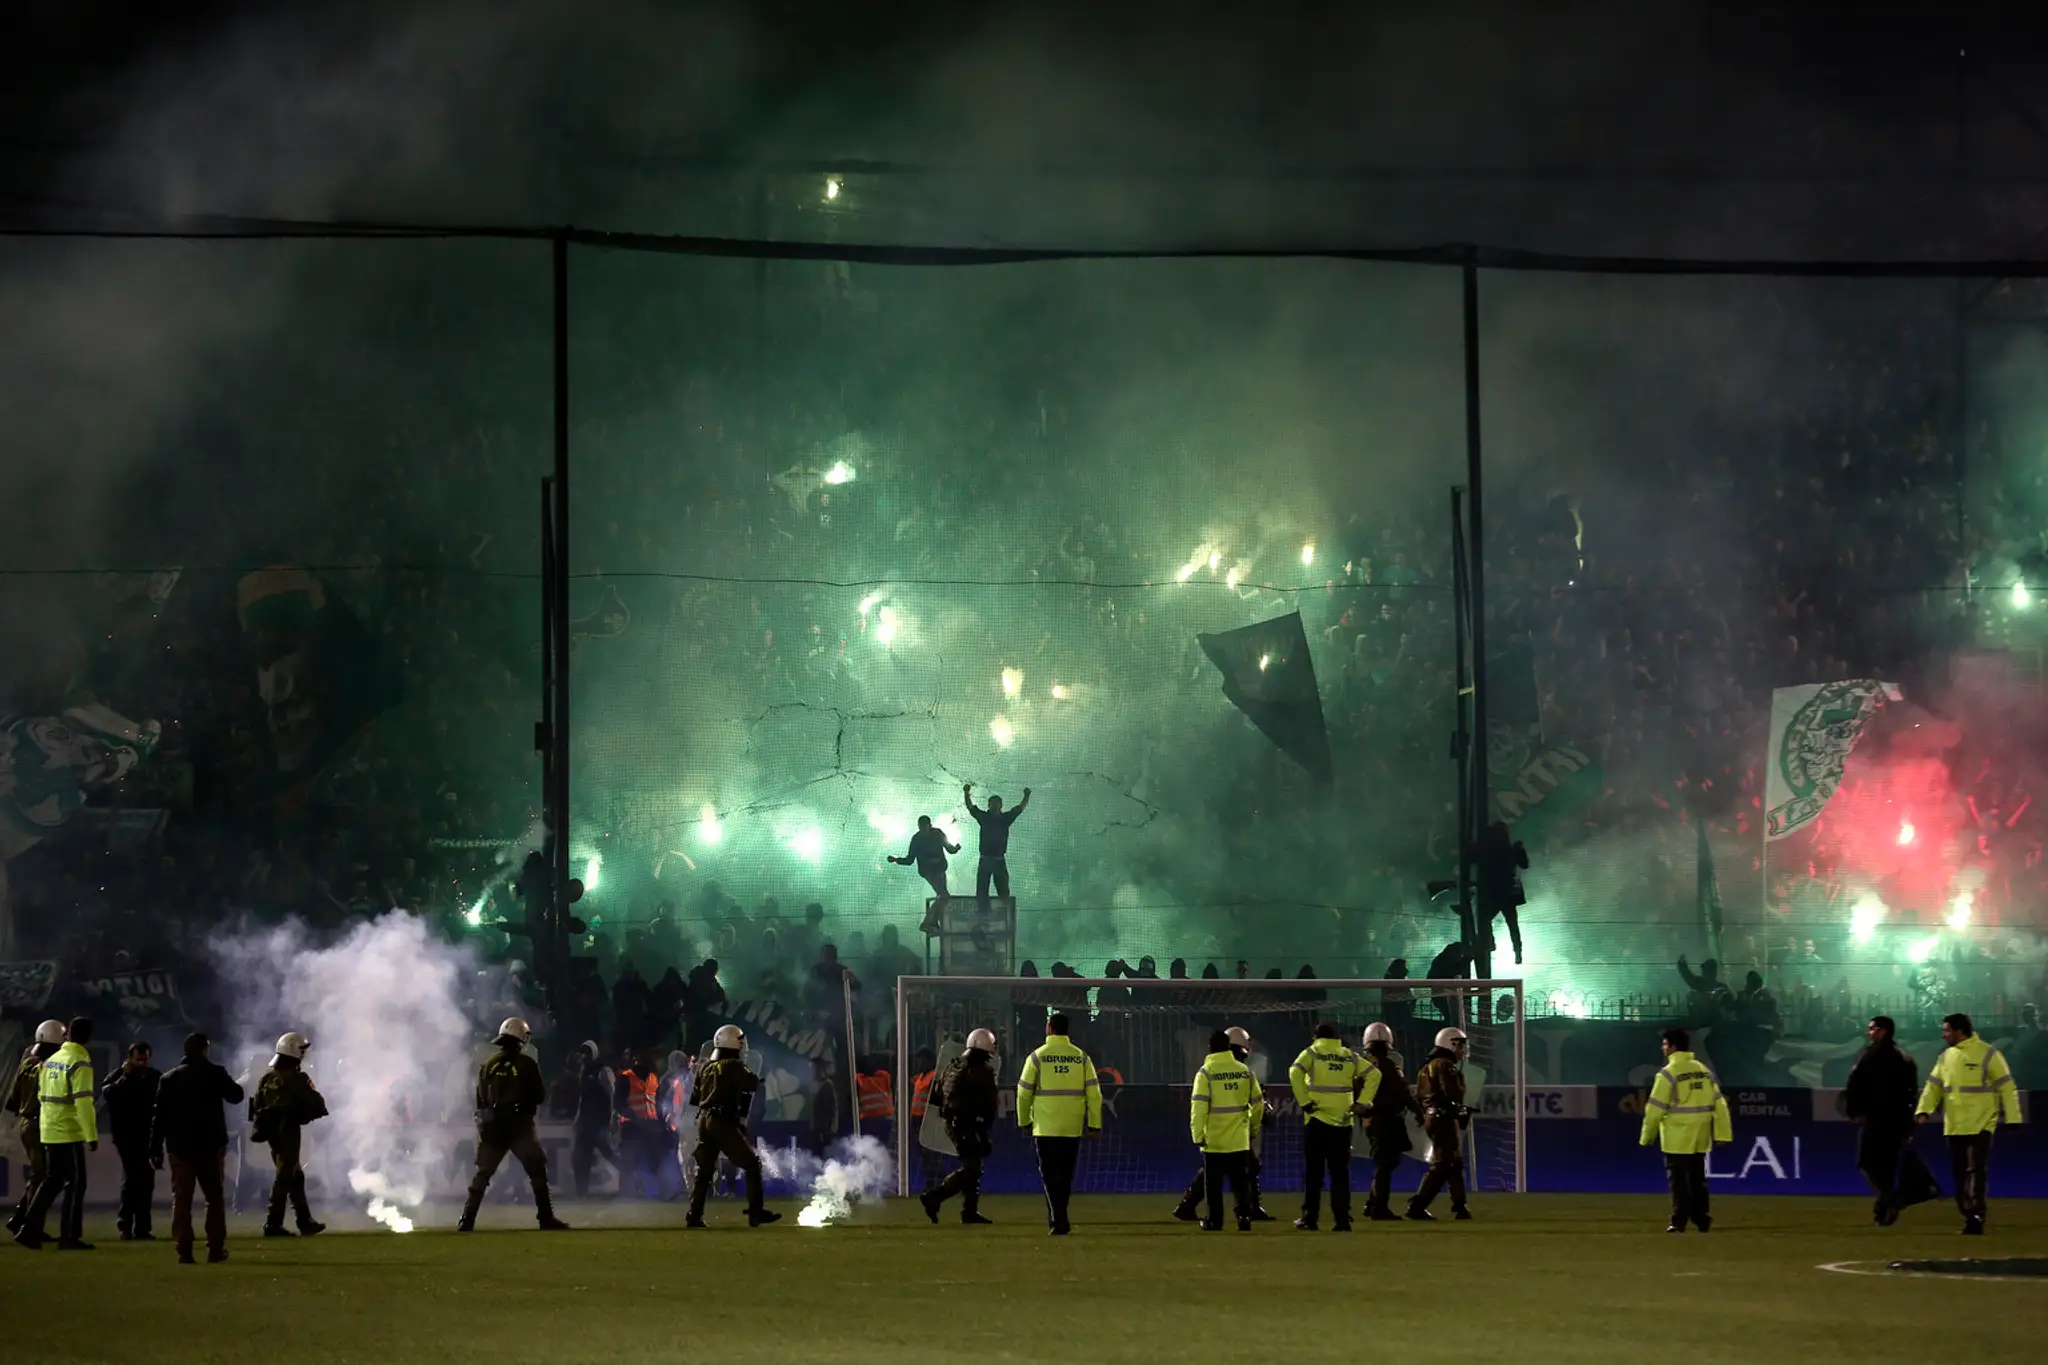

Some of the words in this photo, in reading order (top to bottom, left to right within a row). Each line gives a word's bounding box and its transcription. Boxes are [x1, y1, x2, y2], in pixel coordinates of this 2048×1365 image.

[1054, 1065, 1070, 1073] 125
[1224, 1082, 1239, 1091] 195
[1738, 1092, 1767, 1104] CAR
[1739, 1105, 1792, 1117] RENTAL
